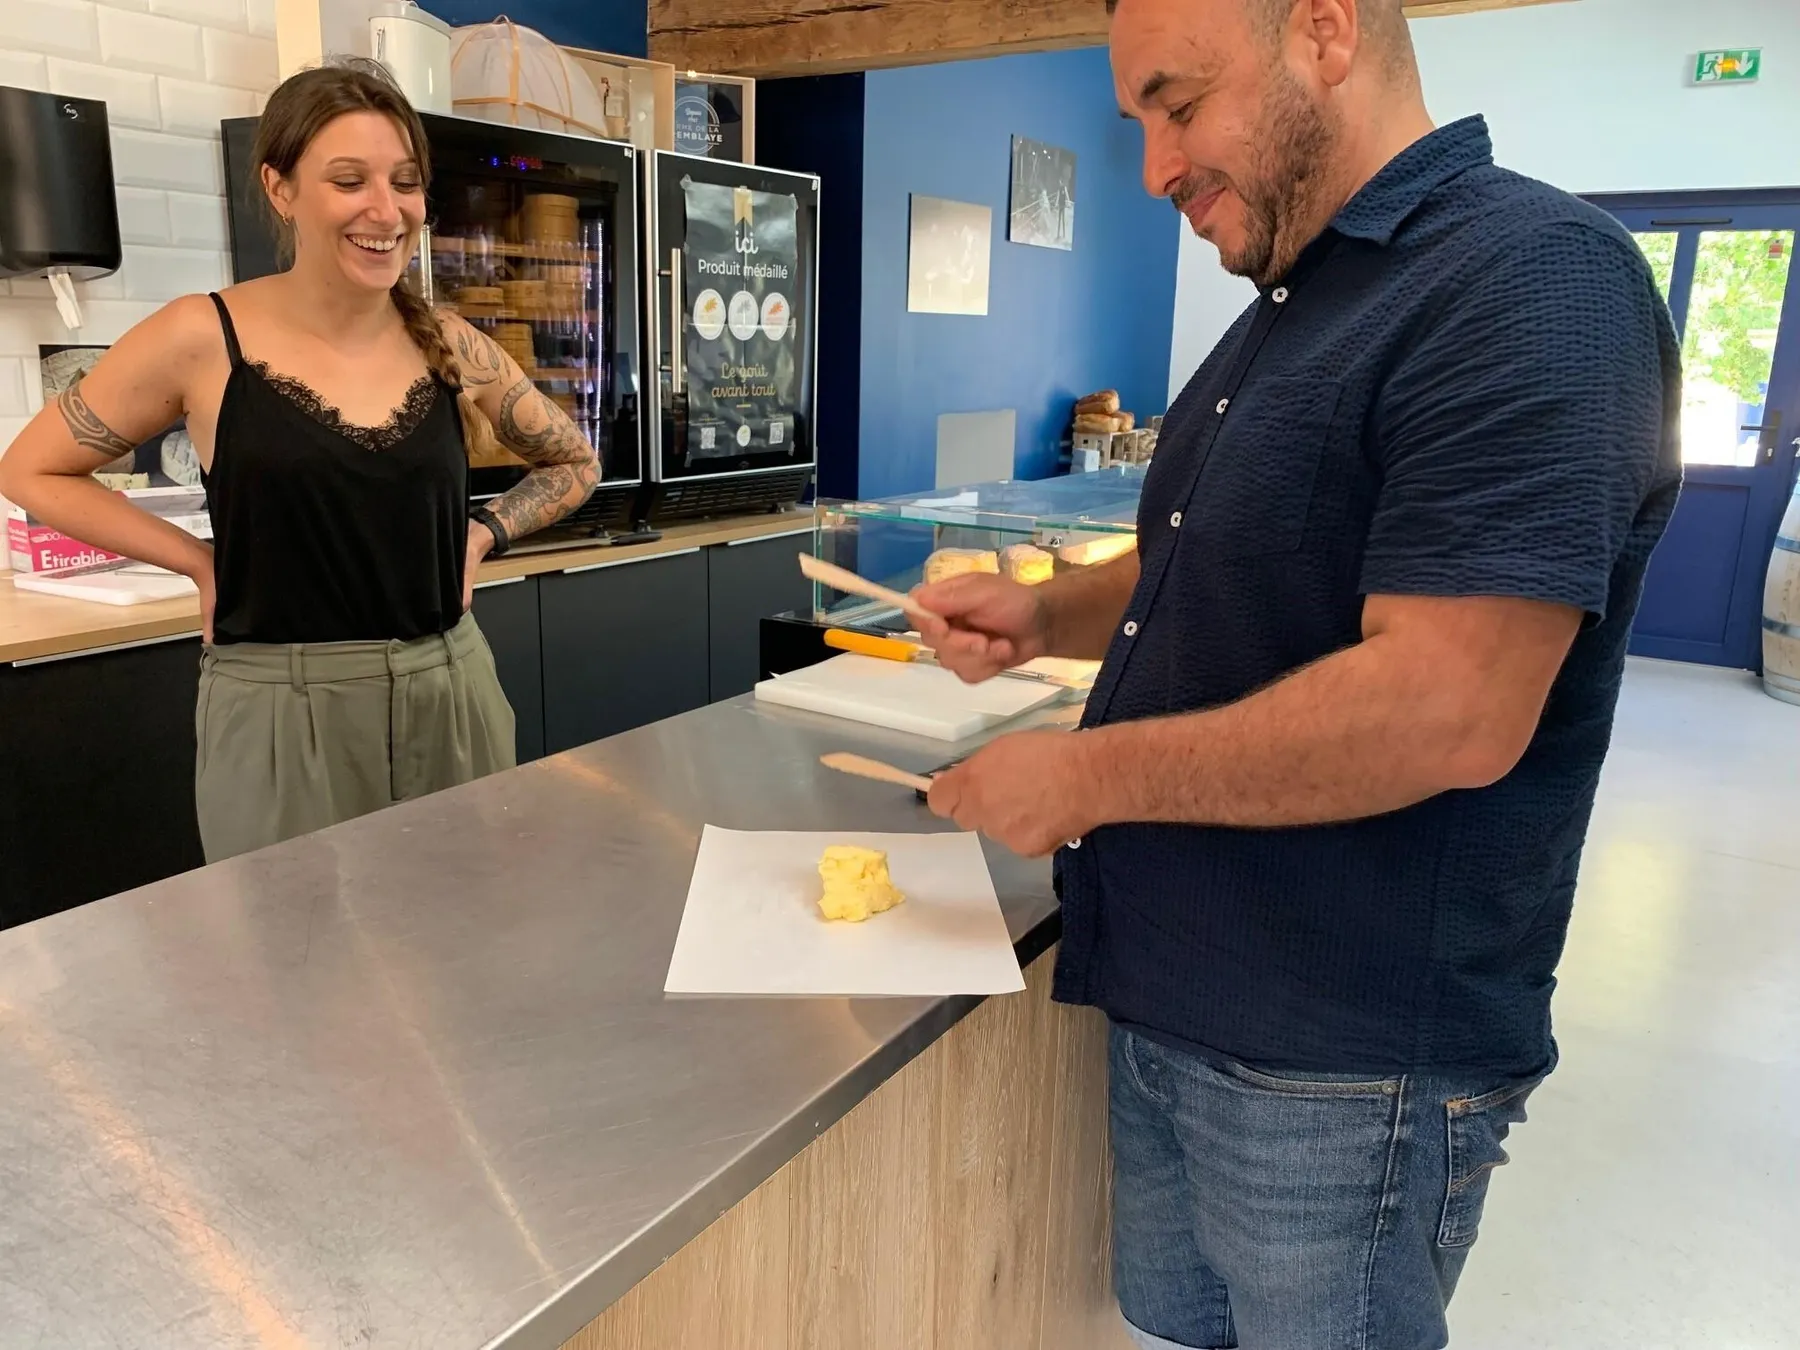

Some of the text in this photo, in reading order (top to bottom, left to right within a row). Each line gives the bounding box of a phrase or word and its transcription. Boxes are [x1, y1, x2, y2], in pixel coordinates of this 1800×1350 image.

[676, 131, 723, 142] EMBLAYE
[735, 230, 759, 254] ici
[698, 259, 788, 279] Produit médaillé
[720, 362, 768, 383] Le goût
[711, 382, 776, 398] avant tout
[40, 549, 107, 569] Etirable
